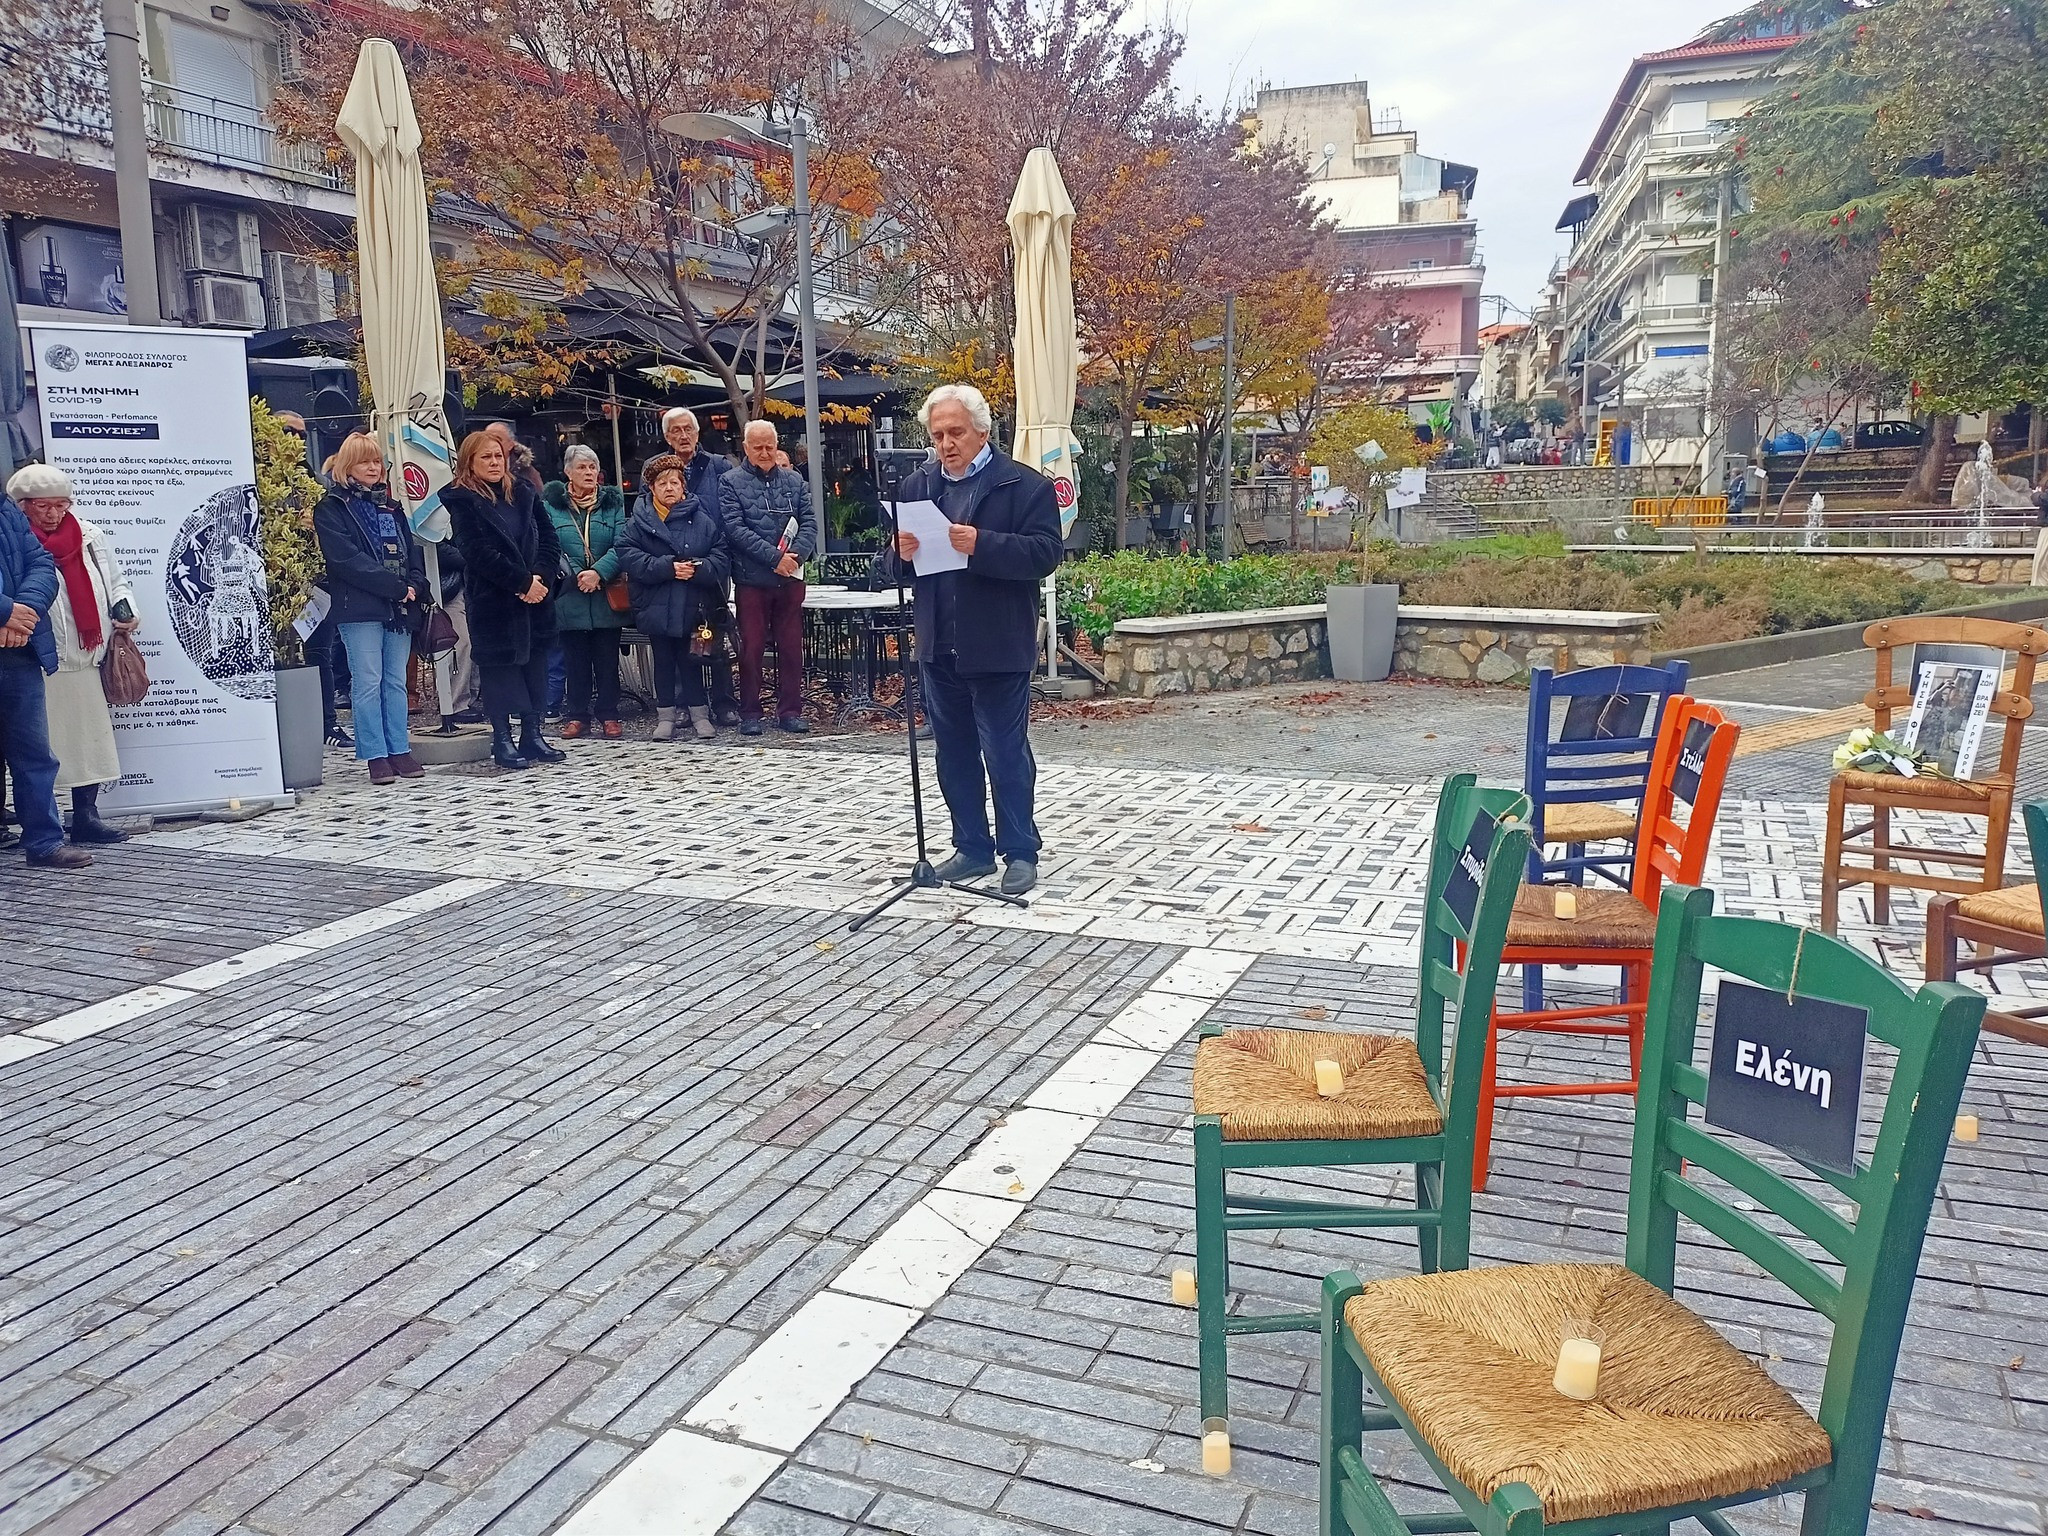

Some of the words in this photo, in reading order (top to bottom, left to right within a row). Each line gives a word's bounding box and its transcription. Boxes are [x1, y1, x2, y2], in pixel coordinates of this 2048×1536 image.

[84, 352, 144, 360] ΦΙΛΟΠΡΟΟΔΟΣ
[146, 353, 188, 361] ΣΥΛΛΟΓΟΣ
[115, 360, 173, 368] ΑΛΕΞΑΝΔΡΟΣ
[47, 386, 77, 394] ΣΤΗ
[82, 387, 139, 396] ΜΝΗΜΗ
[50, 412, 104, 421] Εγκατάσταση
[111, 413, 158, 421] Perfomance
[72, 456, 97, 464] σειρά
[118, 456, 146, 464] άδειες
[148, 457, 190, 465] καρέκλες,
[78, 467, 114, 475] δημόσιο
[141, 467, 182, 476] σιωπηλές,
[167, 478, 185, 486] έξω,
[109, 499, 142, 507] έρθουν.
[135, 517, 166, 525] θυμίζει
[144, 698, 200, 707] καταλάβουμε
[155, 709, 178, 717] κενό,
[179, 707, 200, 715] αλλά
[202, 706, 227, 714] τόπος
[133, 722, 144, 730] με
[166, 719, 199, 727] χάθηκε.
[119, 778, 154, 786] ΕΔΕΣΣΑΣ
[1734, 1039, 1832, 1109] Ελένη
